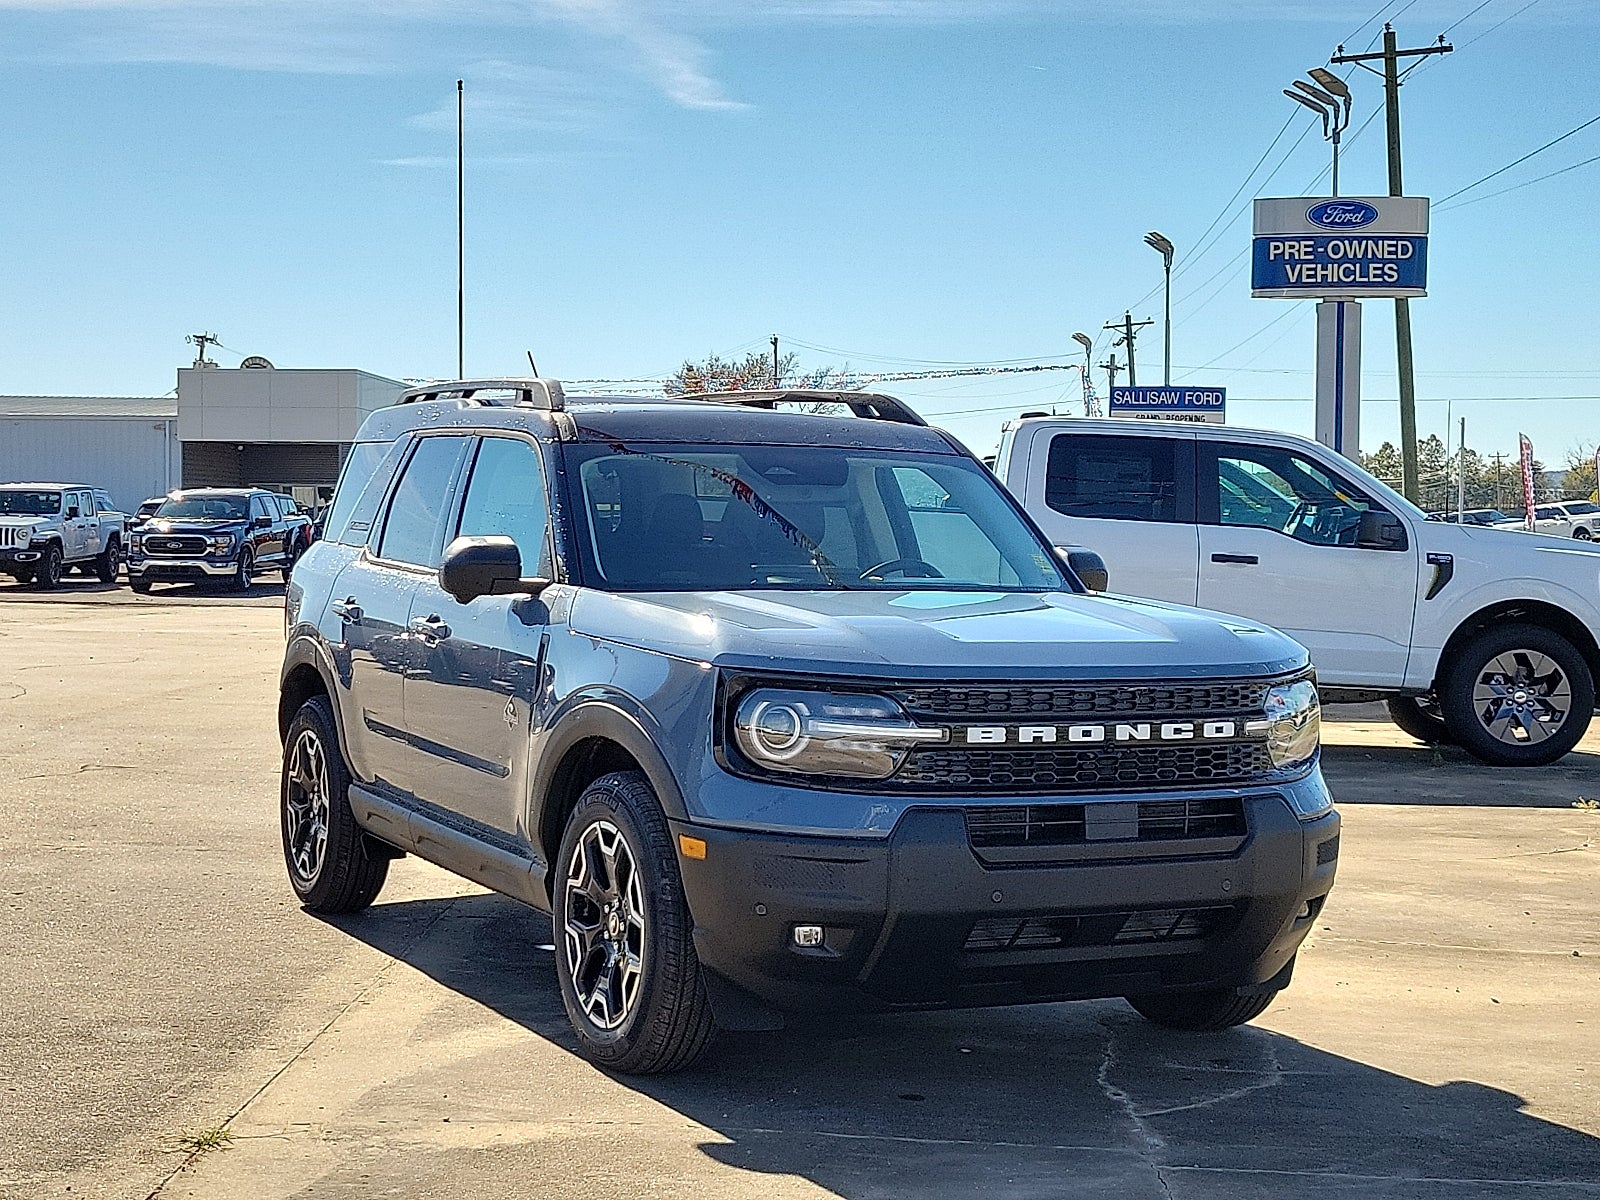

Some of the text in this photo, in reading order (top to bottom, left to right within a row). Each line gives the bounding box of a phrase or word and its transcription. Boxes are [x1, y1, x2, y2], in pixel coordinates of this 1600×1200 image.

[1322, 204, 1366, 223] Ford
[1269, 240, 1414, 260] PRE-OWNED
[1285, 263, 1399, 282] VEHICLES
[1113, 390, 1223, 406] SALLISAW FORD
[966, 721, 1235, 744] BRONCO
